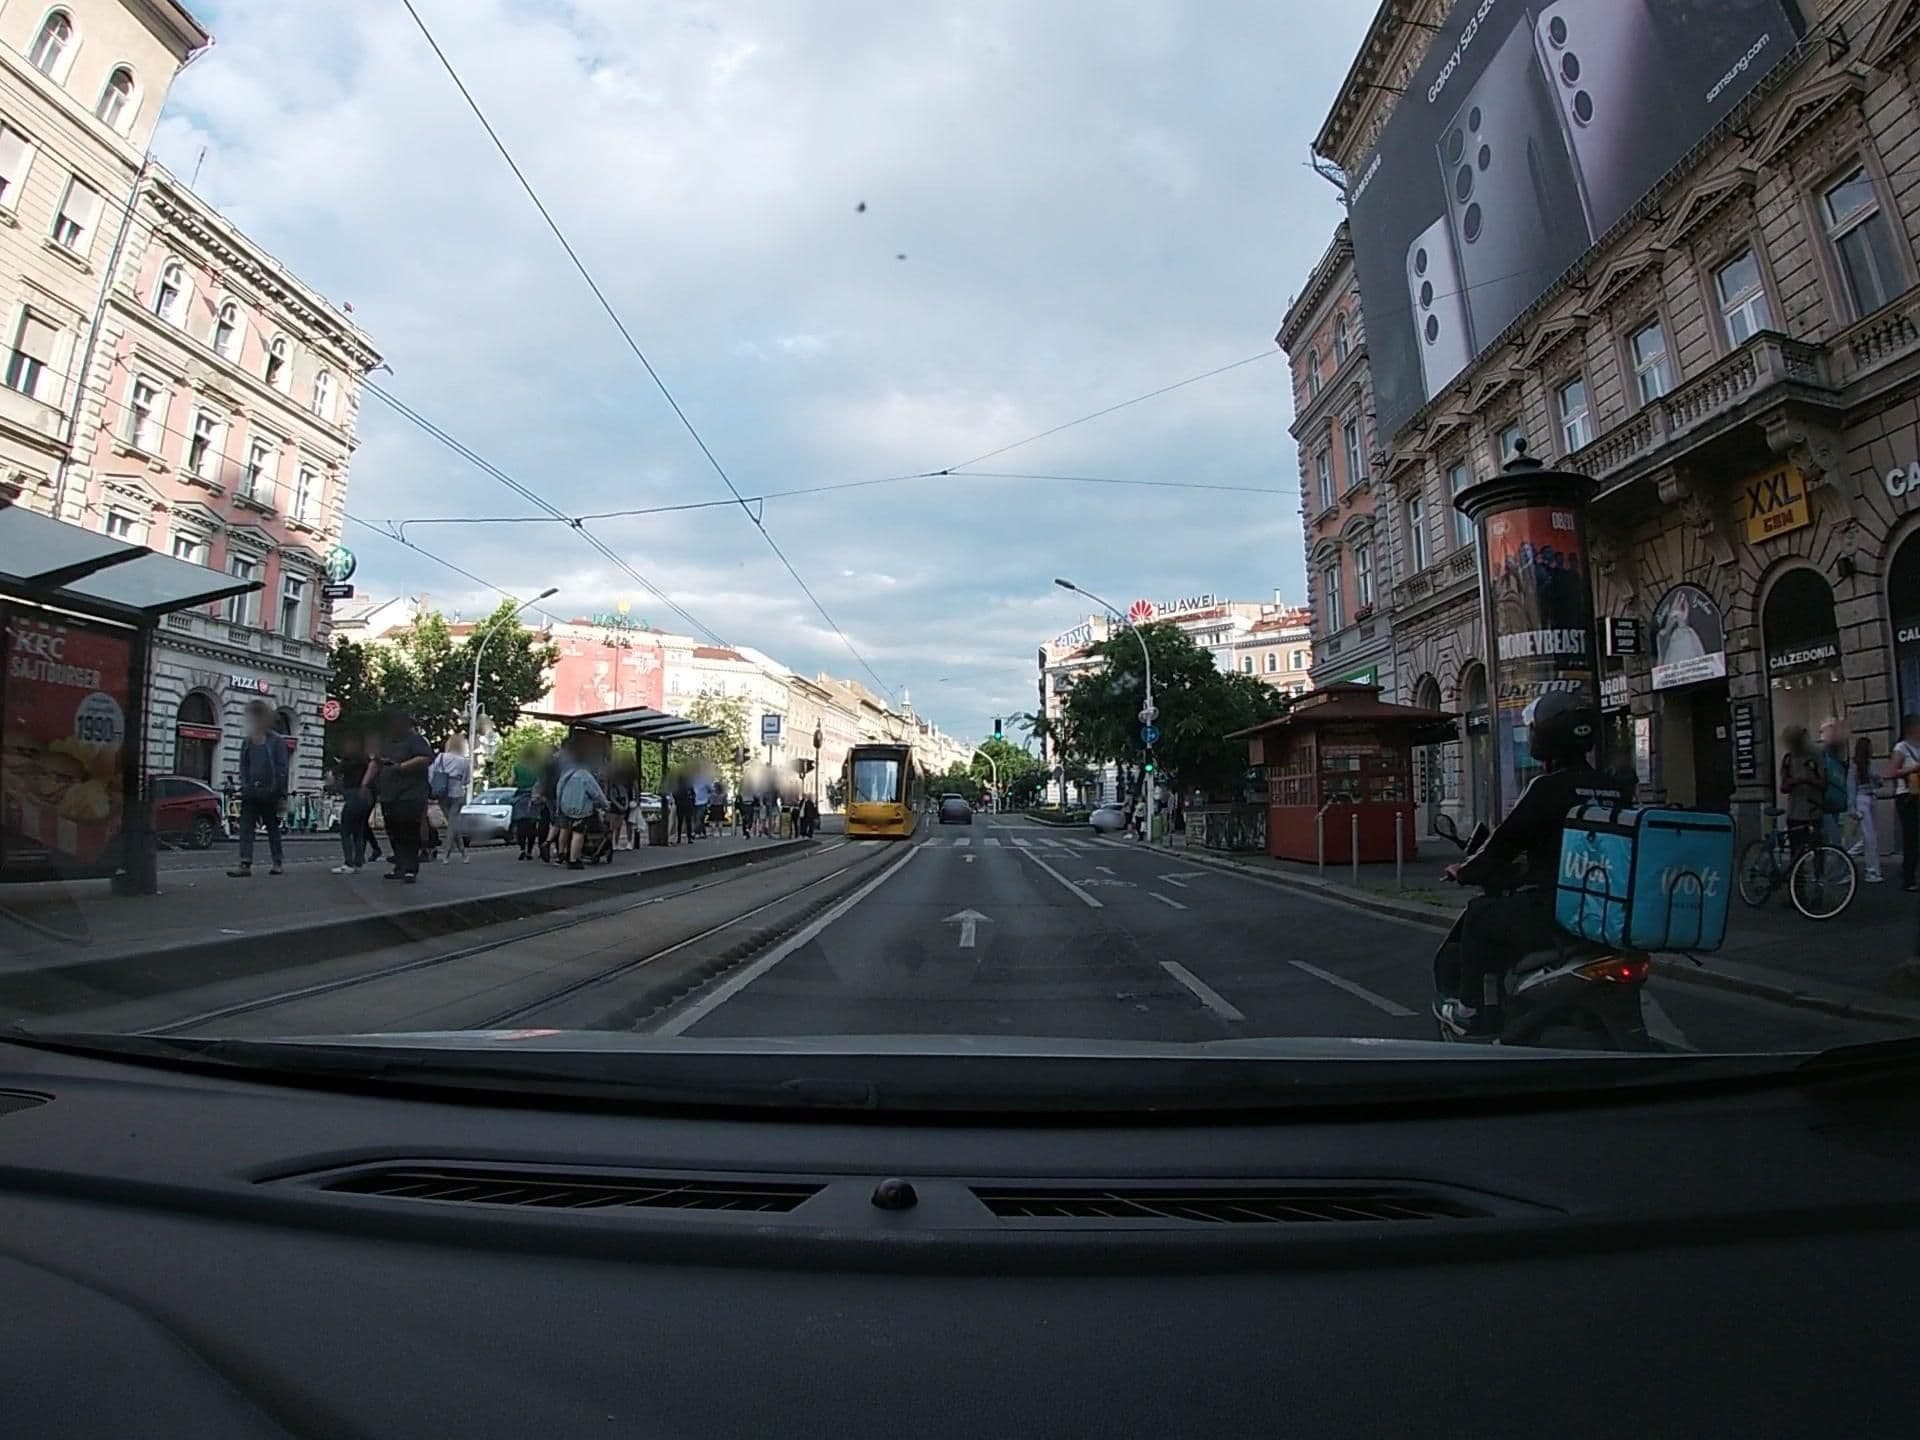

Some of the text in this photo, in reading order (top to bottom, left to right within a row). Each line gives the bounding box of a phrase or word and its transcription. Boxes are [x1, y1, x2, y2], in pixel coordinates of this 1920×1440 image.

[1428, 45, 1461, 103] Galaxy
[1460, 17, 1478, 50] S23
[1706, 33, 1769, 103] samsung.com
[1350, 153, 1382, 206] SAMSUNG
[1747, 472, 1801, 519] XXL
[1157, 593, 1216, 616] HUAWEI
[14, 630, 65, 660] KFC
[1498, 629, 1587, 661] HONEYBEAST
[1769, 645, 1837, 669] CALZEDONIA
[10, 655, 101, 689] SAJTBURGER
[231, 675, 259, 690] PIZZA
[1563, 850, 1614, 883] Wolt
[1661, 864, 1721, 897] Wolt
